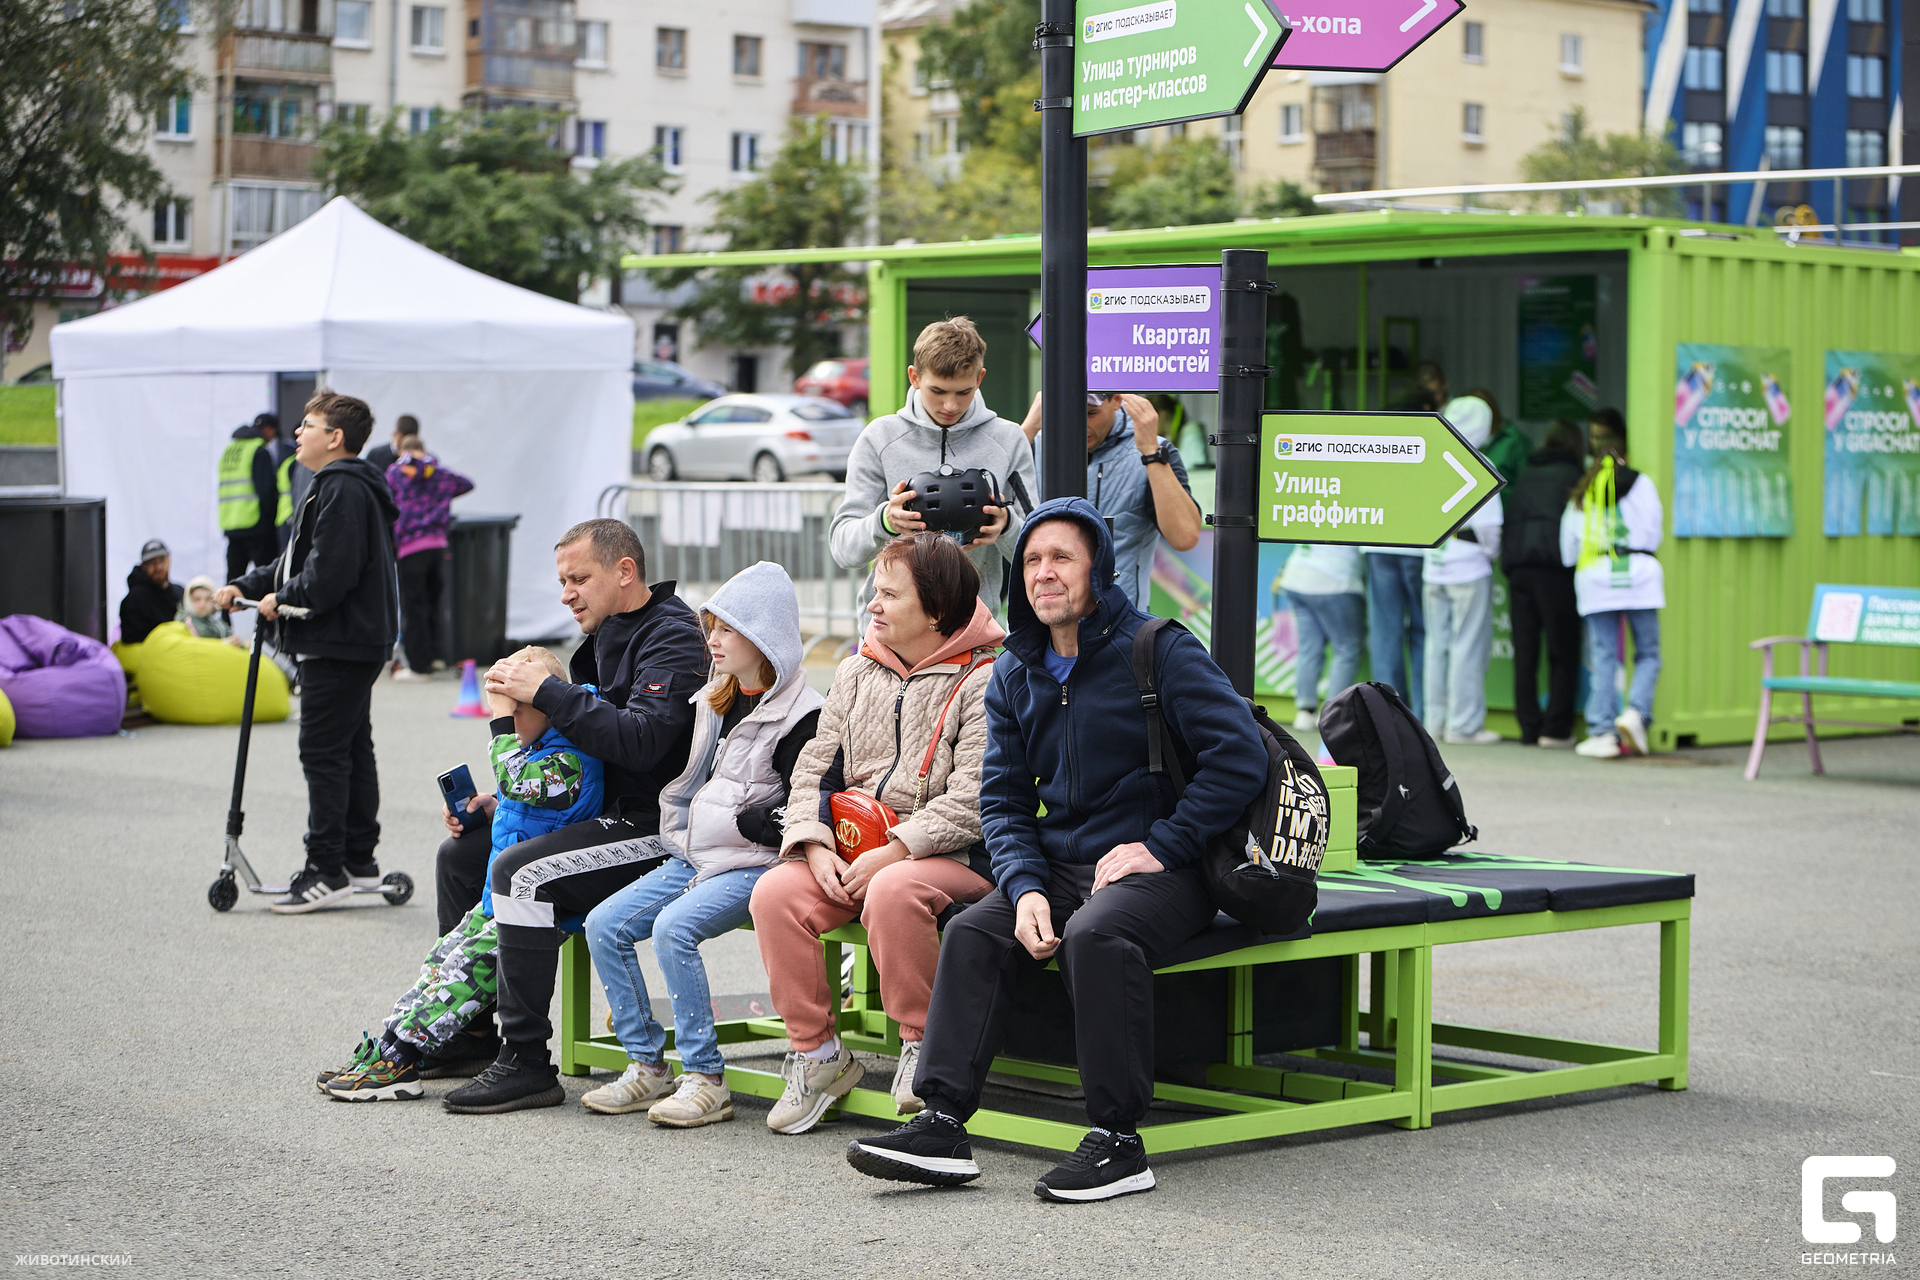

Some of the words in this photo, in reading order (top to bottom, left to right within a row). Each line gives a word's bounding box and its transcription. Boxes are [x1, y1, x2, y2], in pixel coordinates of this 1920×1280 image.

[1095, 20, 1113, 33] 2ГИС
[1115, 8, 1174, 29] ПОДСКАЗЫВАЕТ
[1082, 58, 1124, 83] Улица
[1127, 45, 1197, 79] турниров
[1081, 93, 1090, 112] и
[1093, 73, 1207, 110] мастер-классов
[1104, 296, 1127, 306] 2ГИС
[1130, 294, 1206, 306] ПОДСКАЗЫВАЕТ
[1132, 324, 1210, 350] Квартал
[1090, 348, 1210, 373] активностей
[1295, 442, 1323, 453] 2ГИС
[1327, 443, 1421, 455] ПОДСКАЗЫВАЕТ
[1273, 471, 1341, 498] Улица
[1272, 500, 1384, 528] граффити
